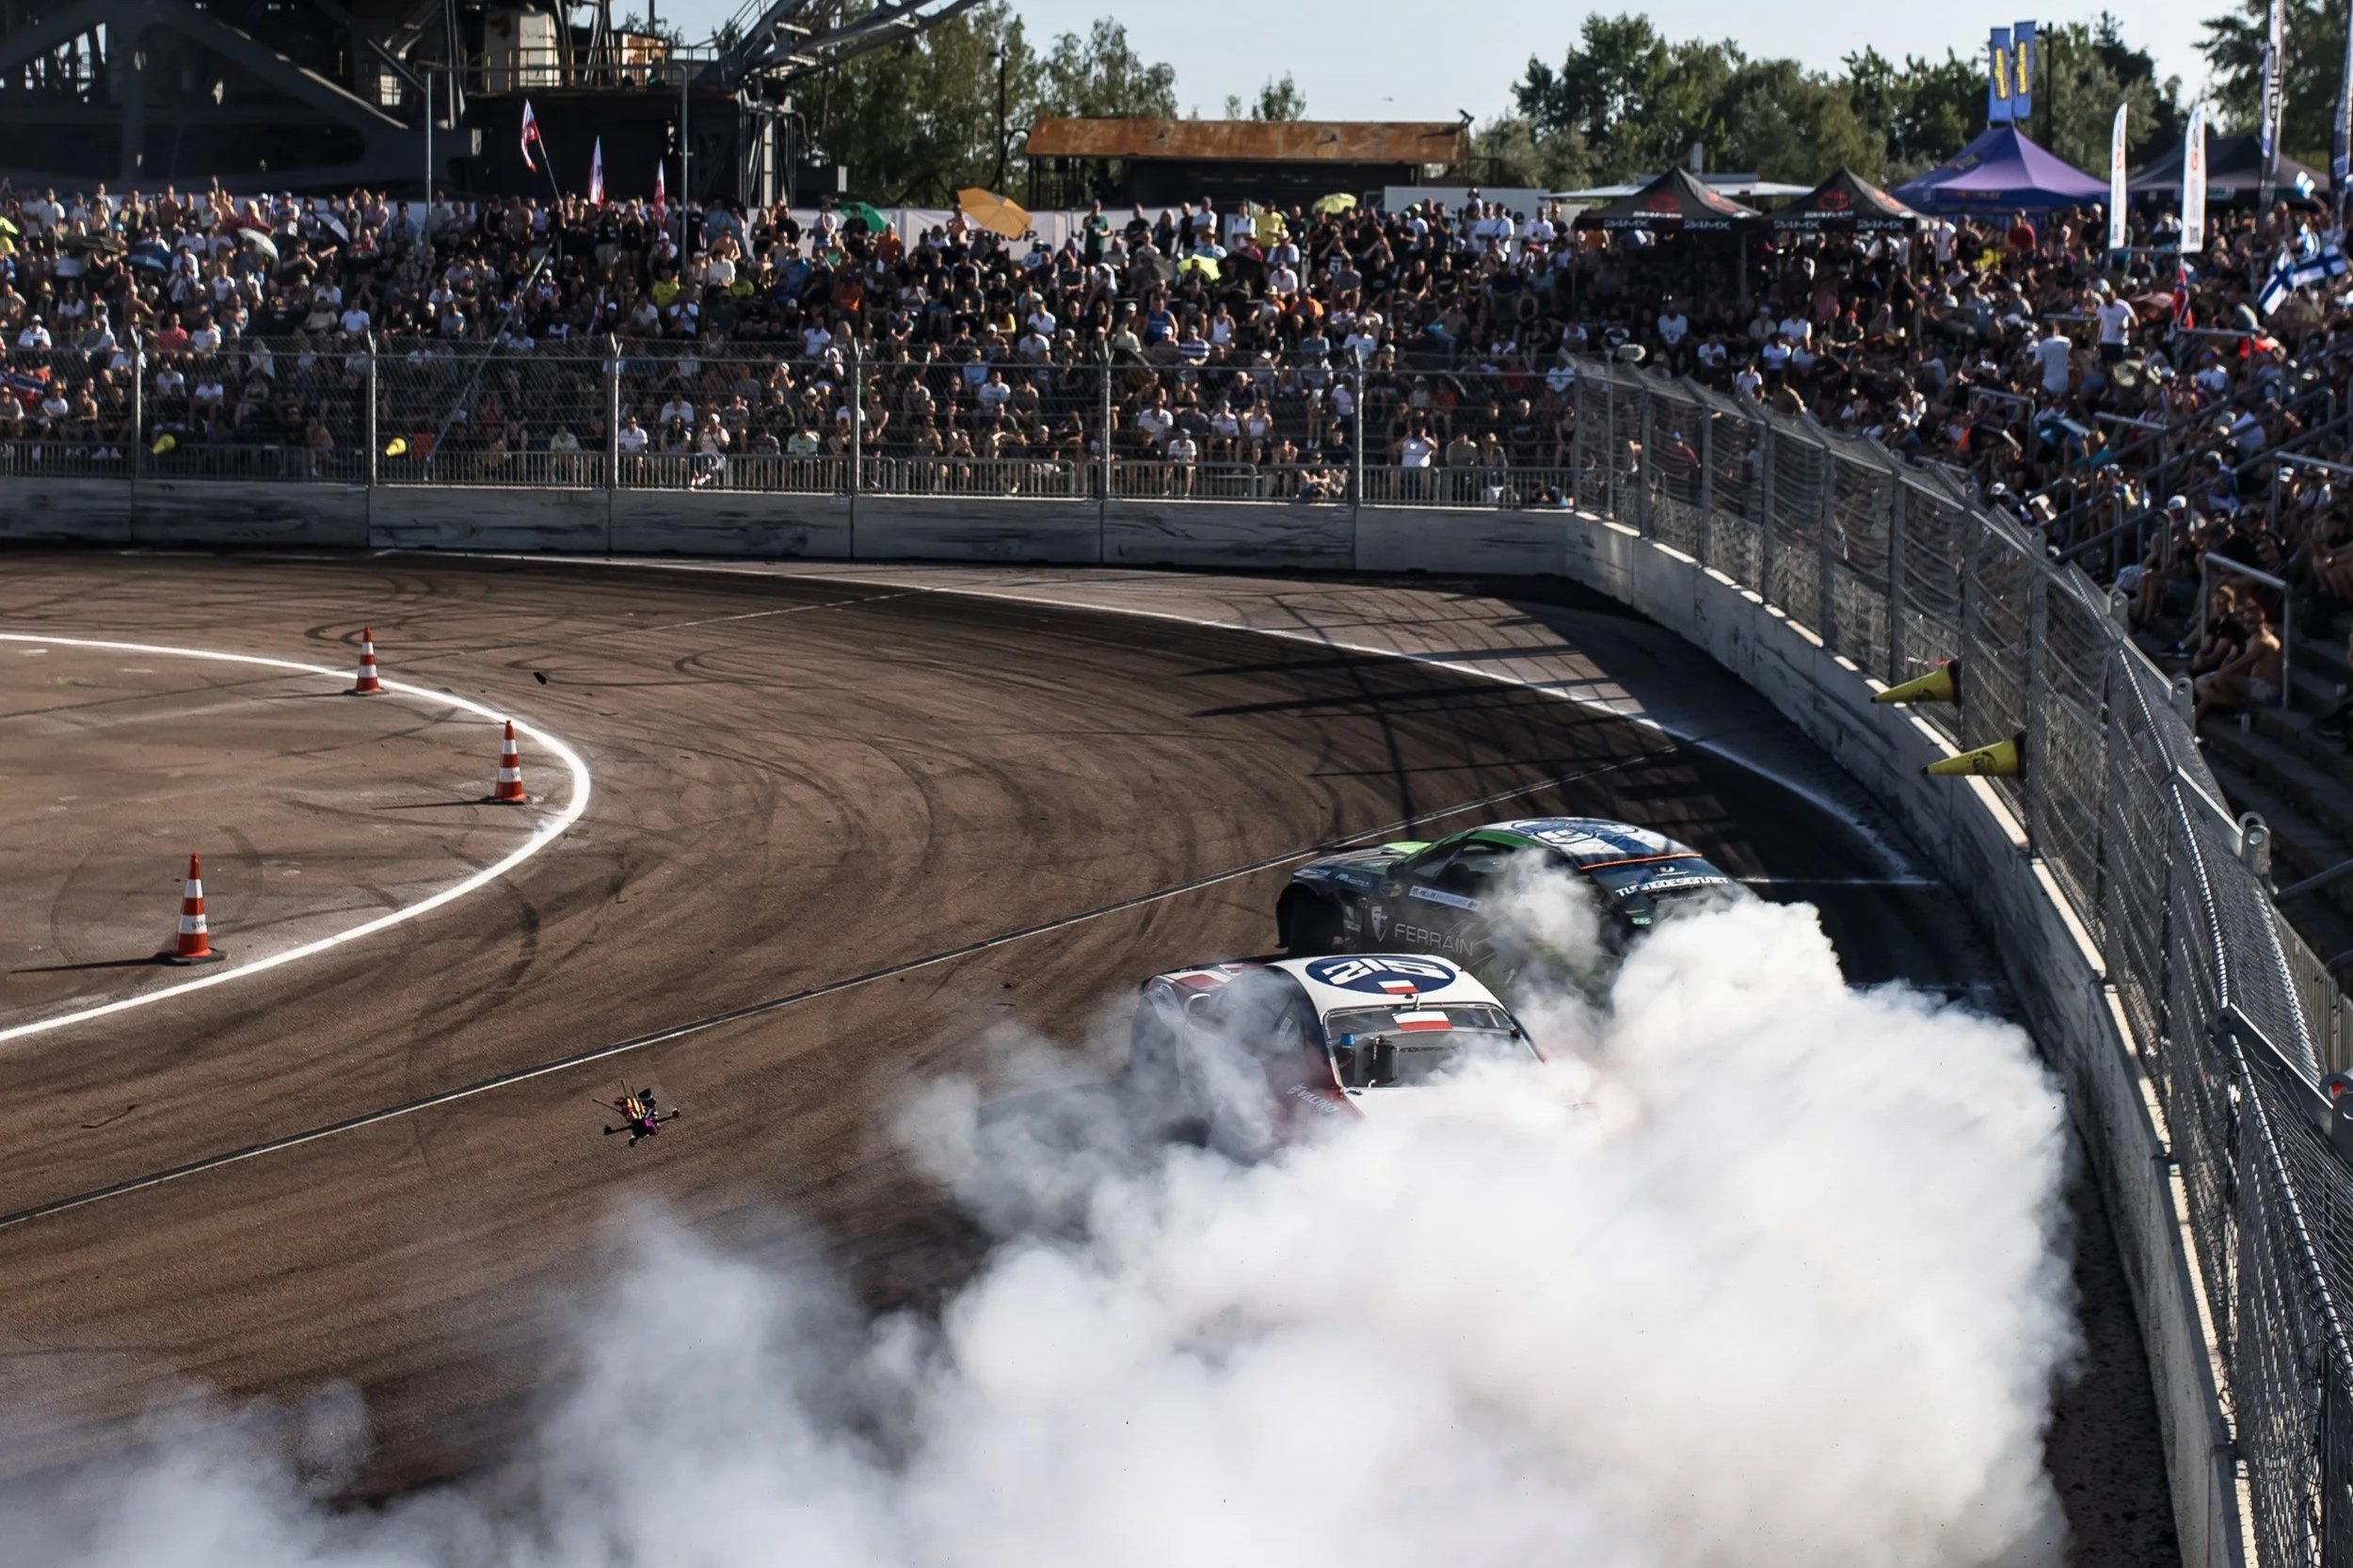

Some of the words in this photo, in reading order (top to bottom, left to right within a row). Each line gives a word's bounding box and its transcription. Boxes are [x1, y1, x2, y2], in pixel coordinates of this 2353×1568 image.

[1394, 923, 1475, 957] FERRAIN
[1321, 957, 1450, 985] 215
[1296, 1090, 1340, 1112] VALINO
